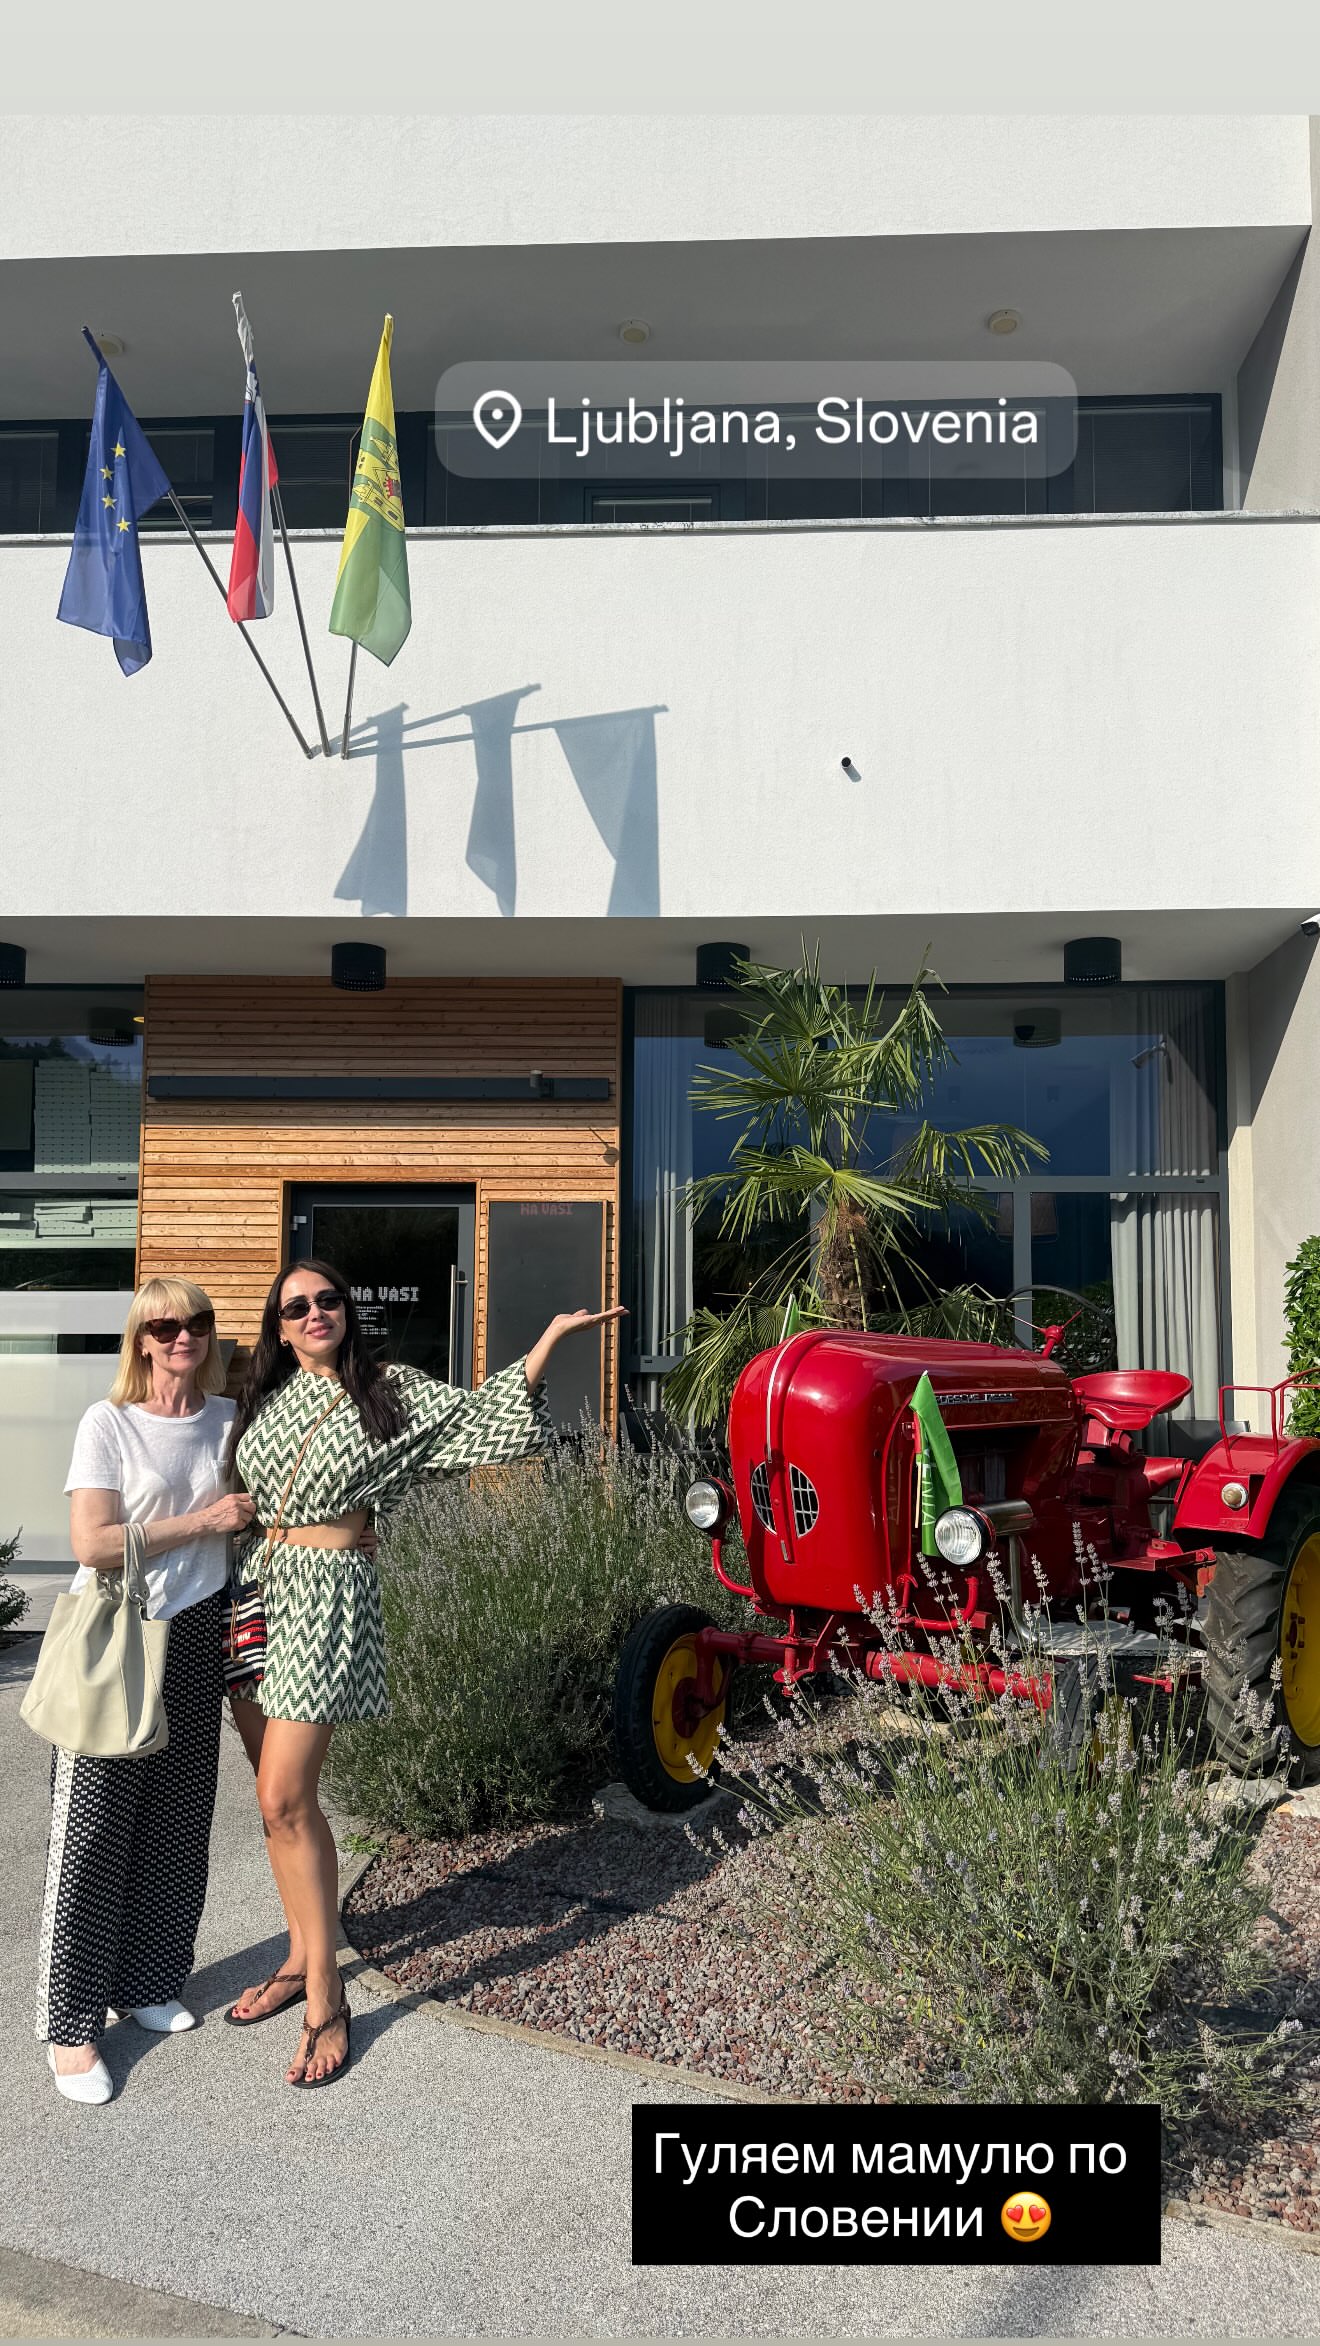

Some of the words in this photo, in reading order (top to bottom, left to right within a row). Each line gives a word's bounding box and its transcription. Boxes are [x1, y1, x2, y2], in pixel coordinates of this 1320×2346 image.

[520, 1203, 538, 1216] NA
[541, 1202, 574, 1216] VASI
[350, 1286, 373, 1301] NA
[378, 1286, 419, 1301] VASI
